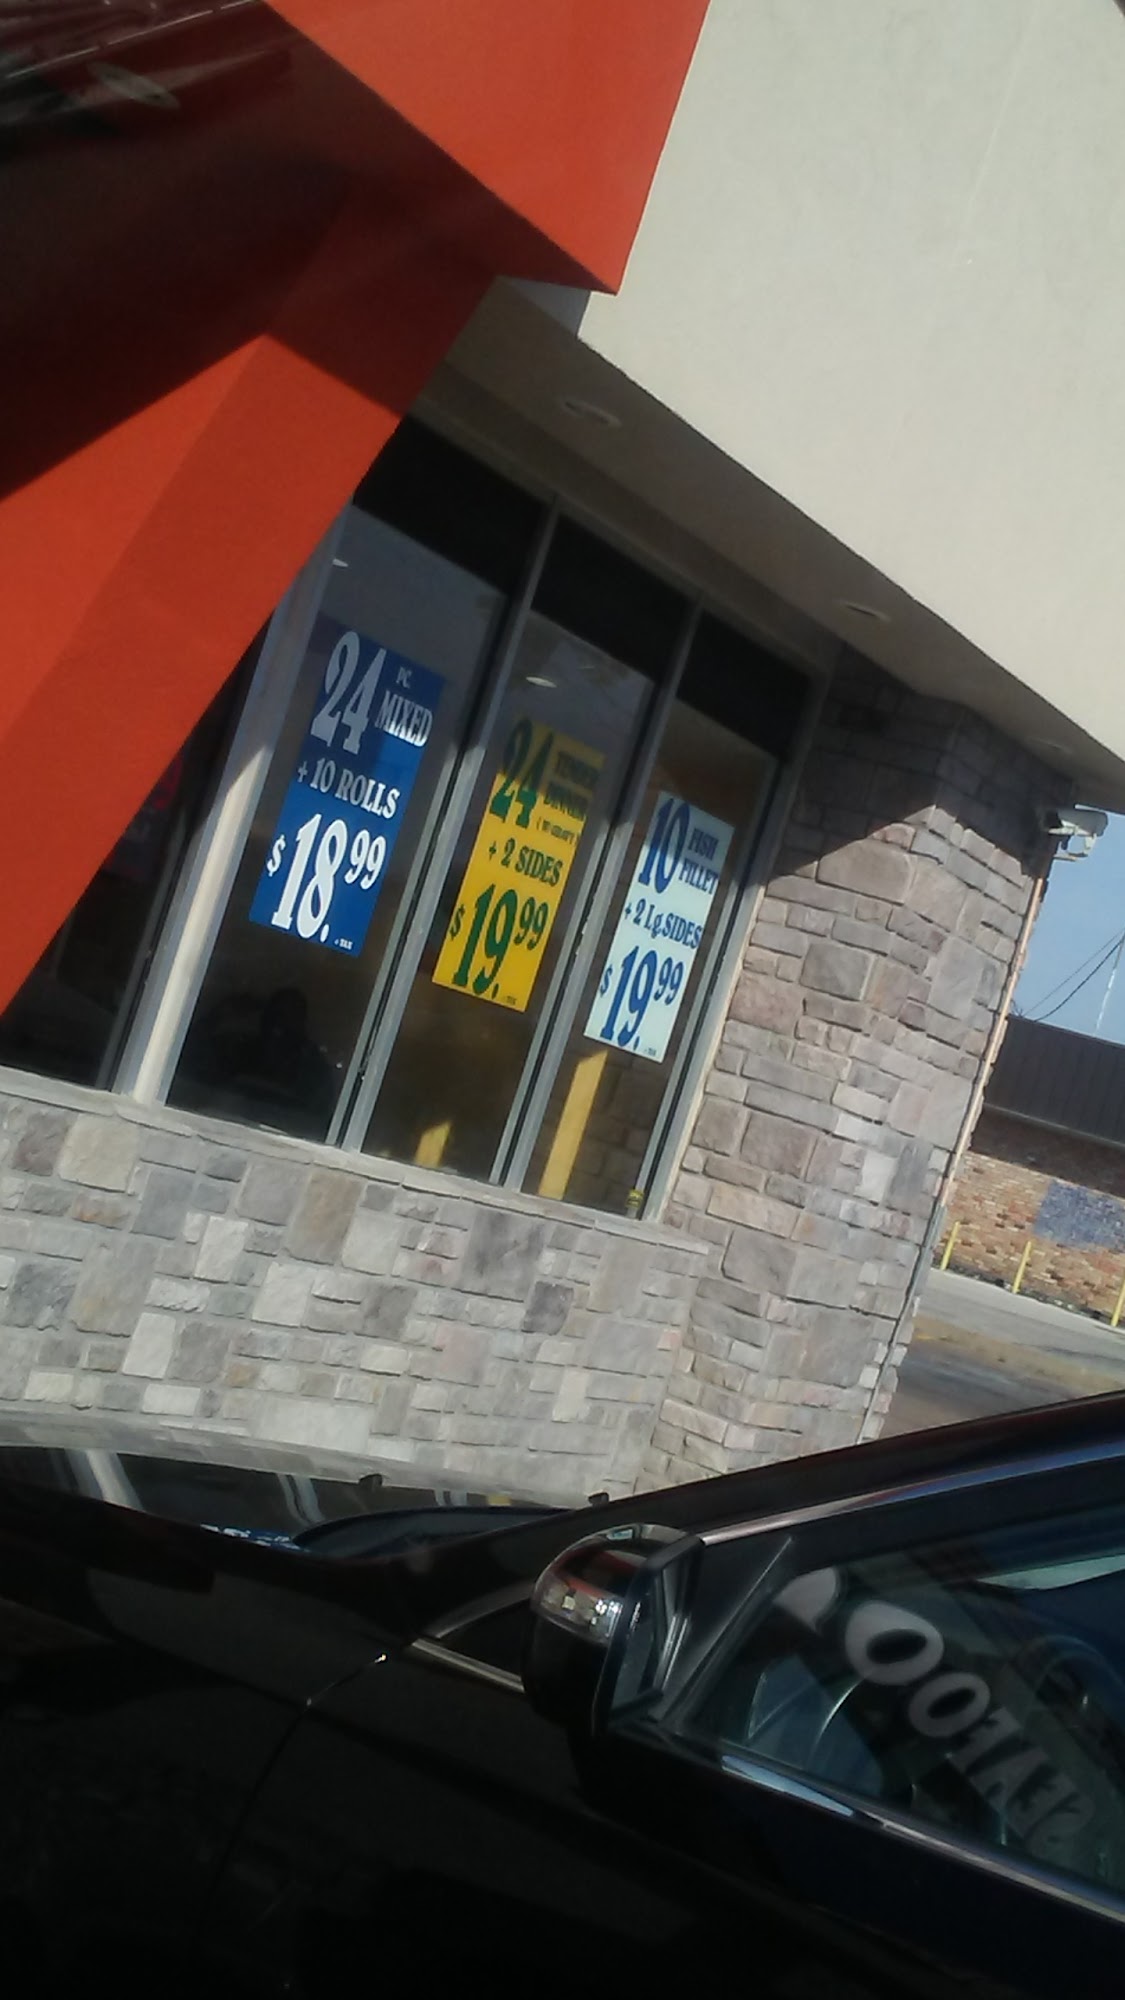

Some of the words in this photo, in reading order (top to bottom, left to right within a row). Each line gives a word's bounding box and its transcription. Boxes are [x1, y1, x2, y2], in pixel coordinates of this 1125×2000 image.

[311, 631, 386, 755] 24
[374, 690, 433, 747] MIXED
[310, 758, 336, 793] 10
[335, 769, 400, 819] ROLLS
[490, 717, 553, 829] 24
[501, 838, 515, 868] 2
[515, 845, 563, 887] SIDES
[638, 798, 690, 894] 10
[688, 827, 719, 861] FISH
[678, 857, 719, 895] FILLET
[633, 898, 646, 925] 2
[662, 912, 703, 949] SIDES
